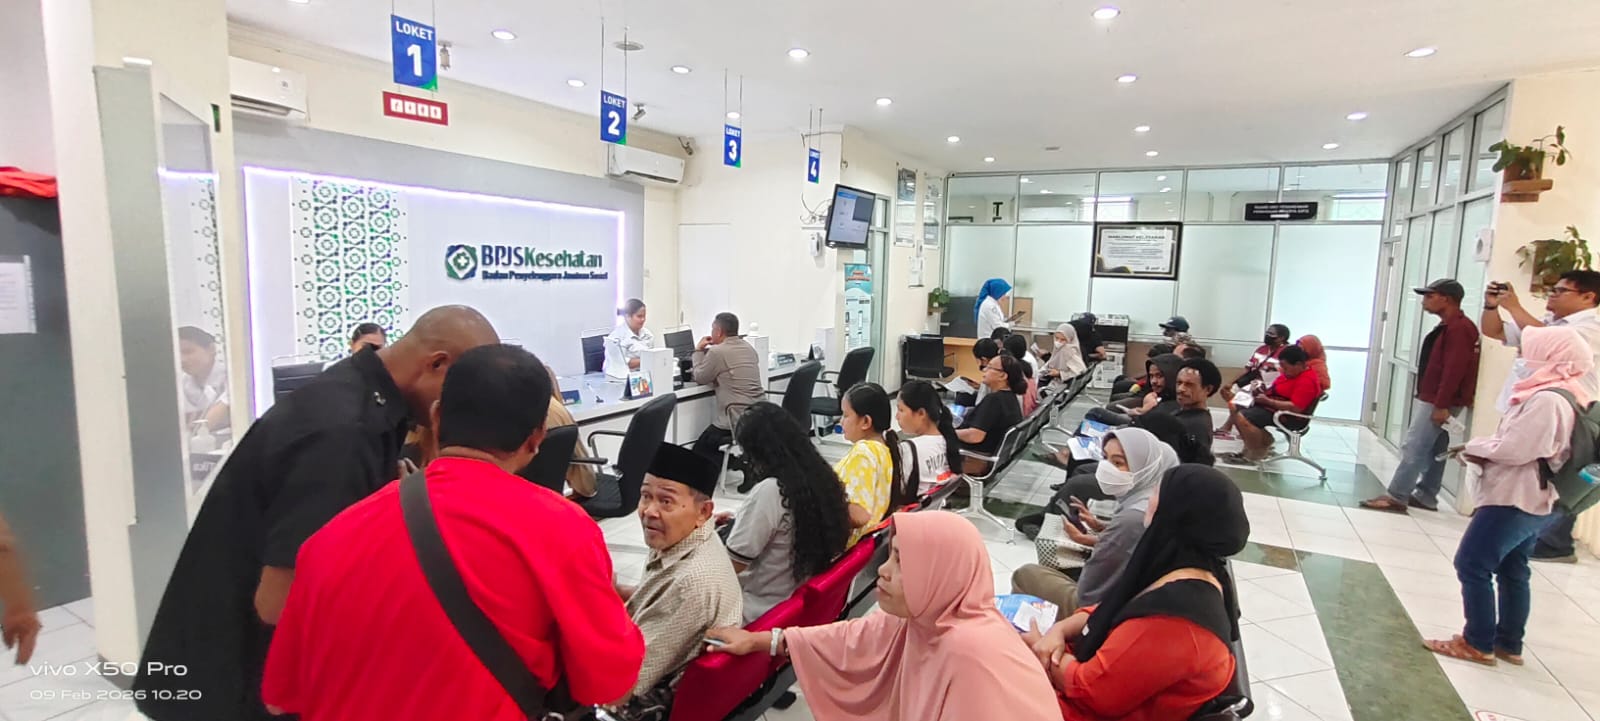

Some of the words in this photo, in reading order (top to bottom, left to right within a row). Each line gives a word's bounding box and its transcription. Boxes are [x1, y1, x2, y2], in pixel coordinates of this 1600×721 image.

[395, 20, 434, 41] LOKET
[406, 43, 423, 77] 1
[603, 94, 625, 109] LOKET
[607, 110, 620, 136] 2
[728, 139, 738, 161] 3
[810, 160, 817, 177] 4
